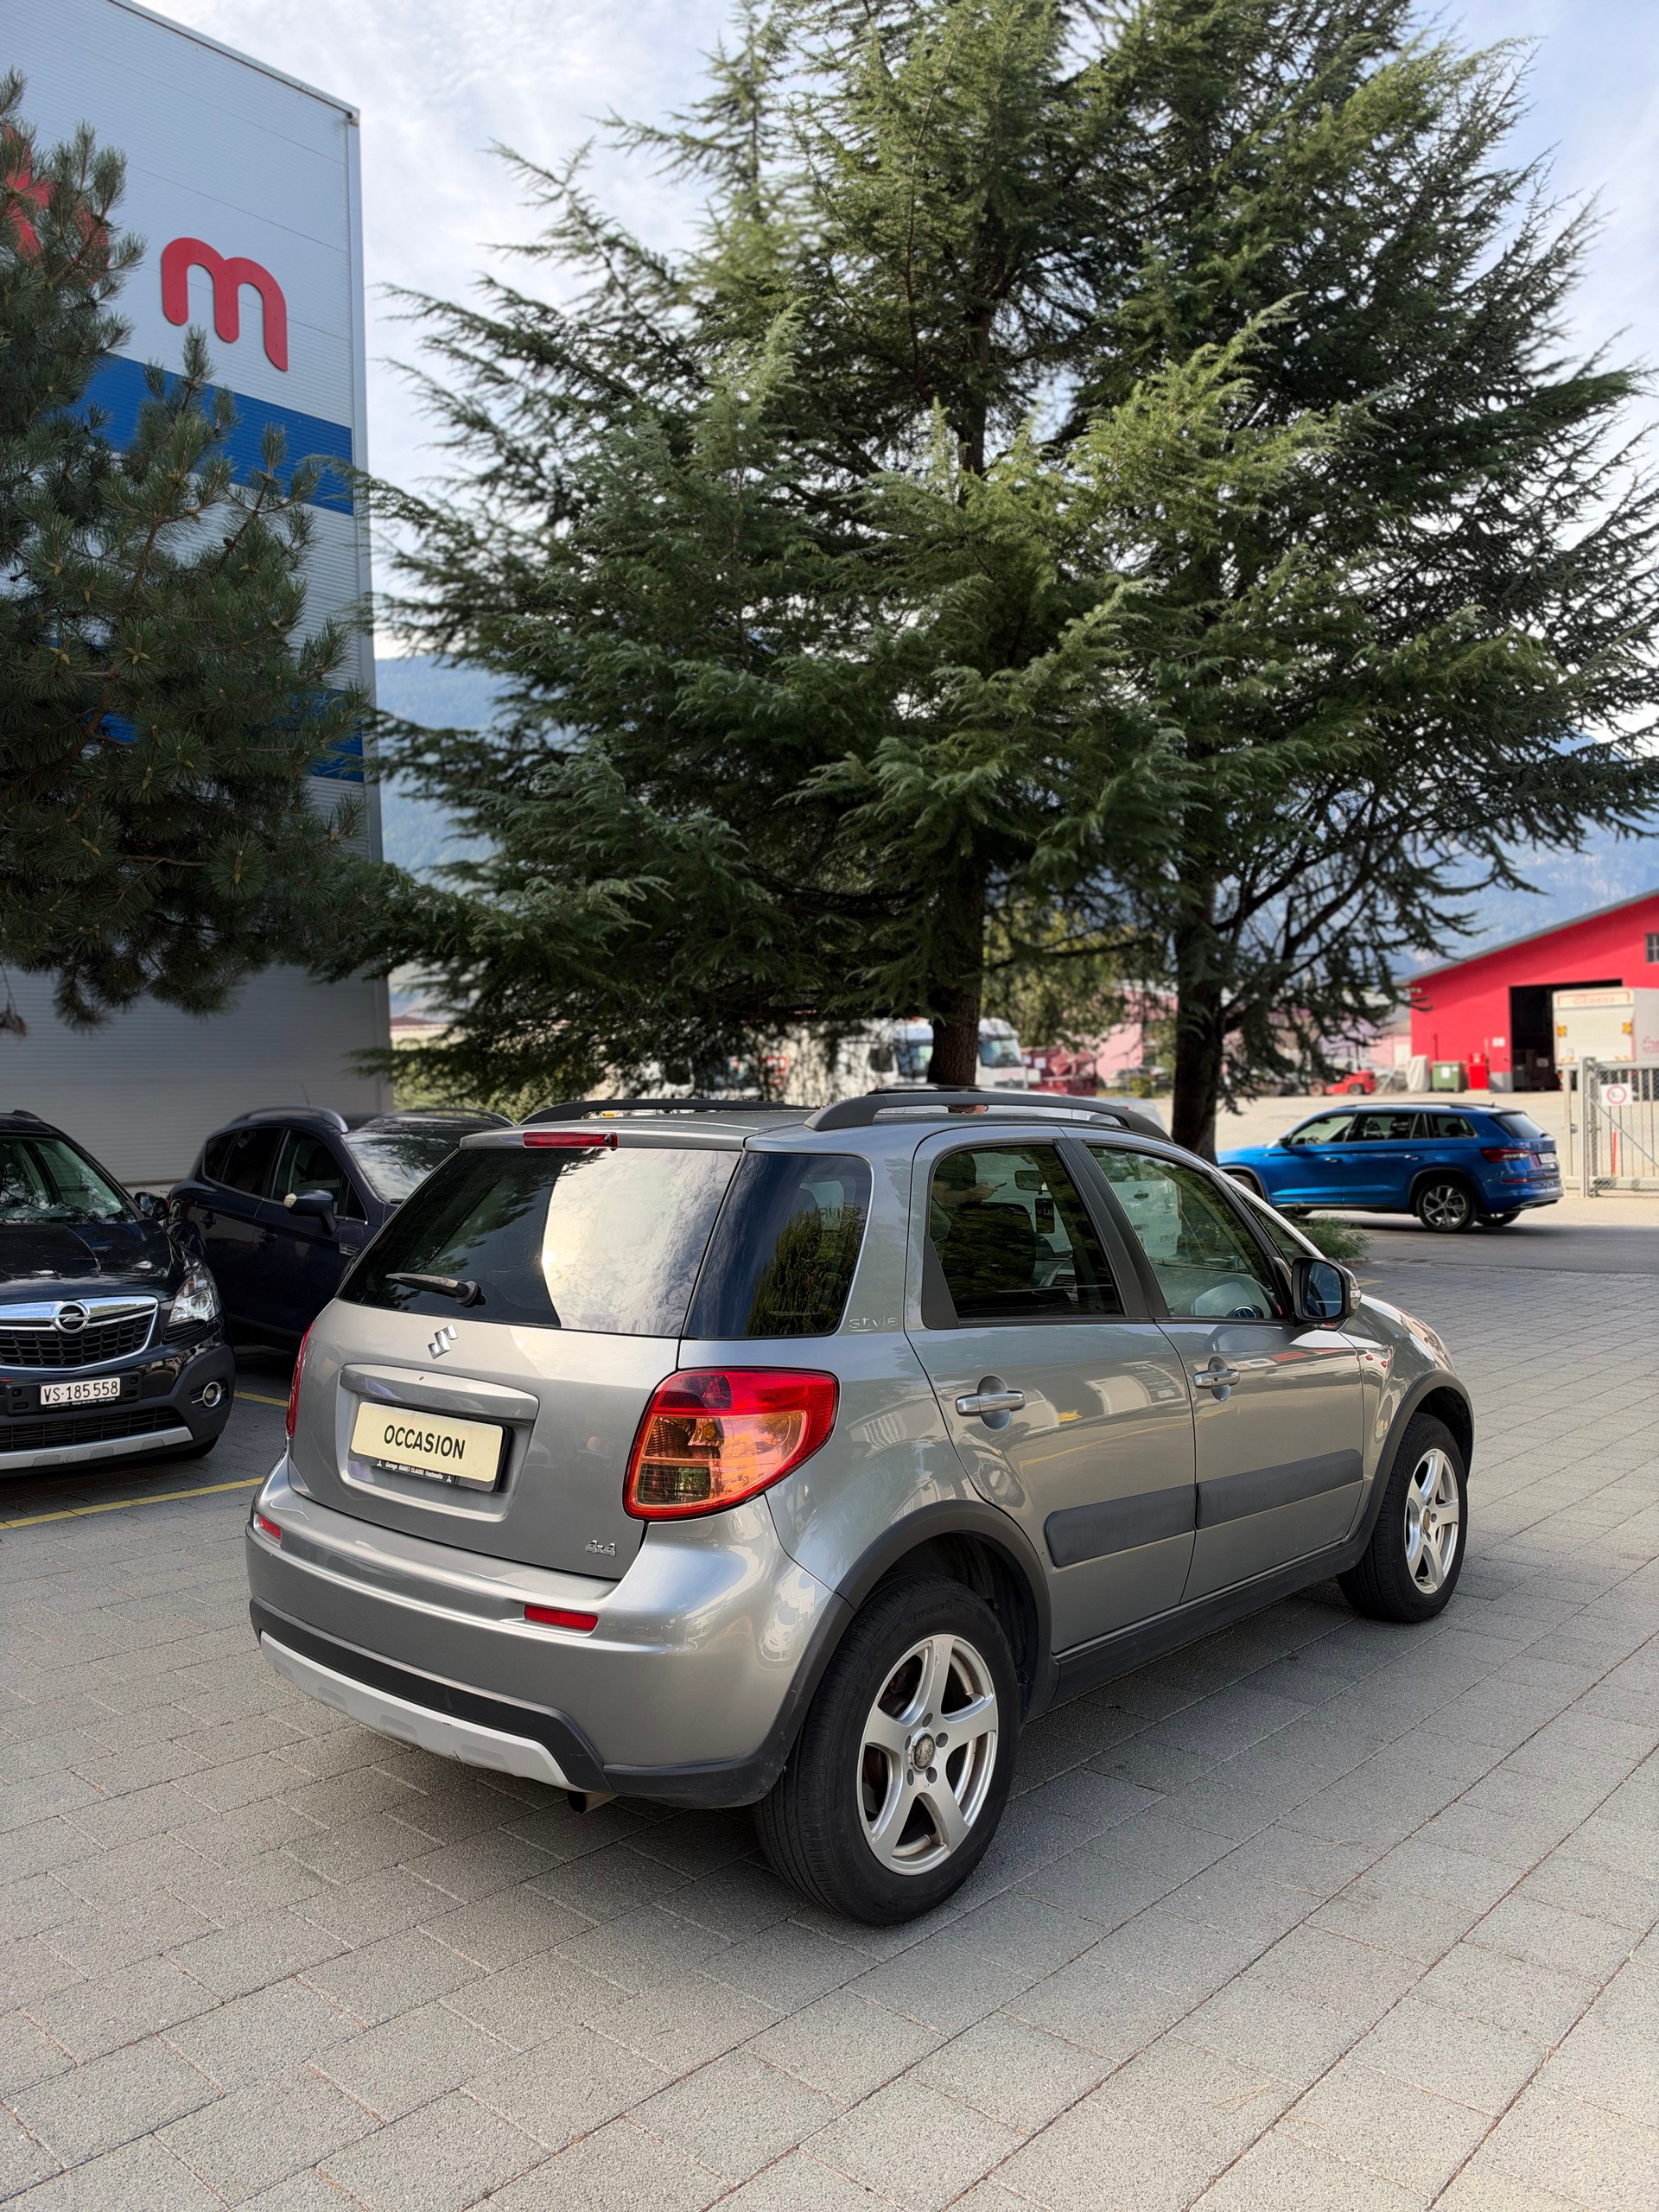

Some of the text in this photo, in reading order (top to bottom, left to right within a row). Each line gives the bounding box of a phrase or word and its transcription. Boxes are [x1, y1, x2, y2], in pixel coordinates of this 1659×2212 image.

[384, 1424, 466, 1459] OCCASION
[385, 1461, 398, 1471] Garage
[585, 1540, 616, 1556] 4x4
